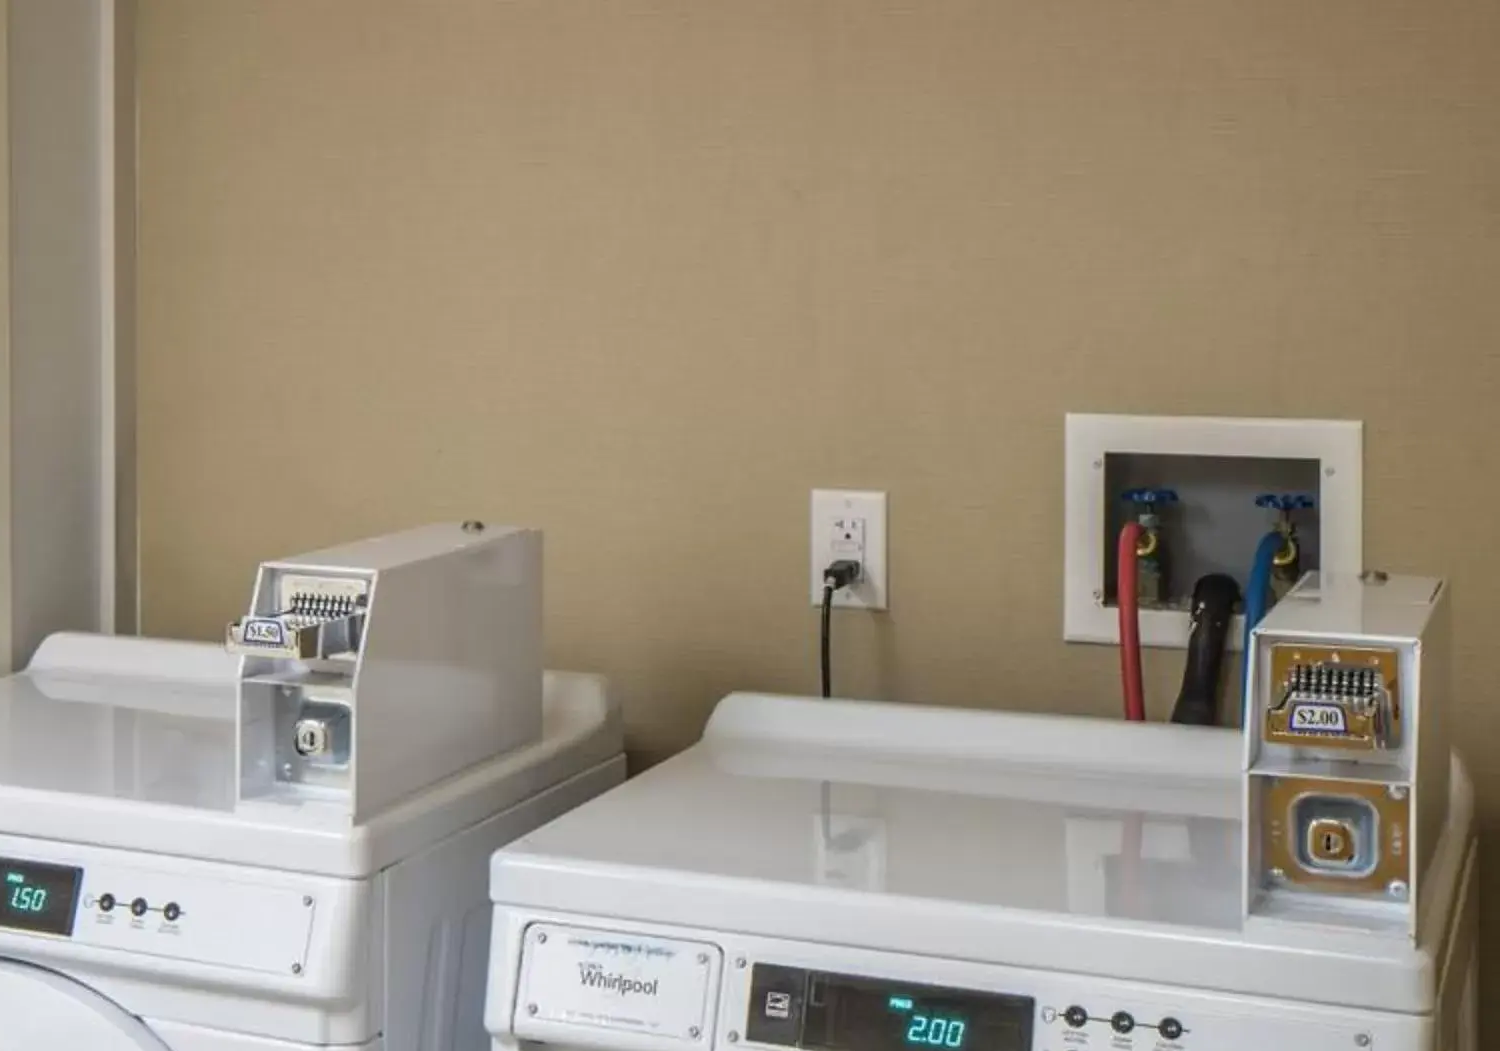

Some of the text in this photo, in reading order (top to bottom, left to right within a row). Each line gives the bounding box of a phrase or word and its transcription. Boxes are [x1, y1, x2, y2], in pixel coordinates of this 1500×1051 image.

[1297, 709, 1339, 726] $2.00
[579, 968, 660, 997] Whirlpool
[907, 1015, 965, 1047] 2.00
